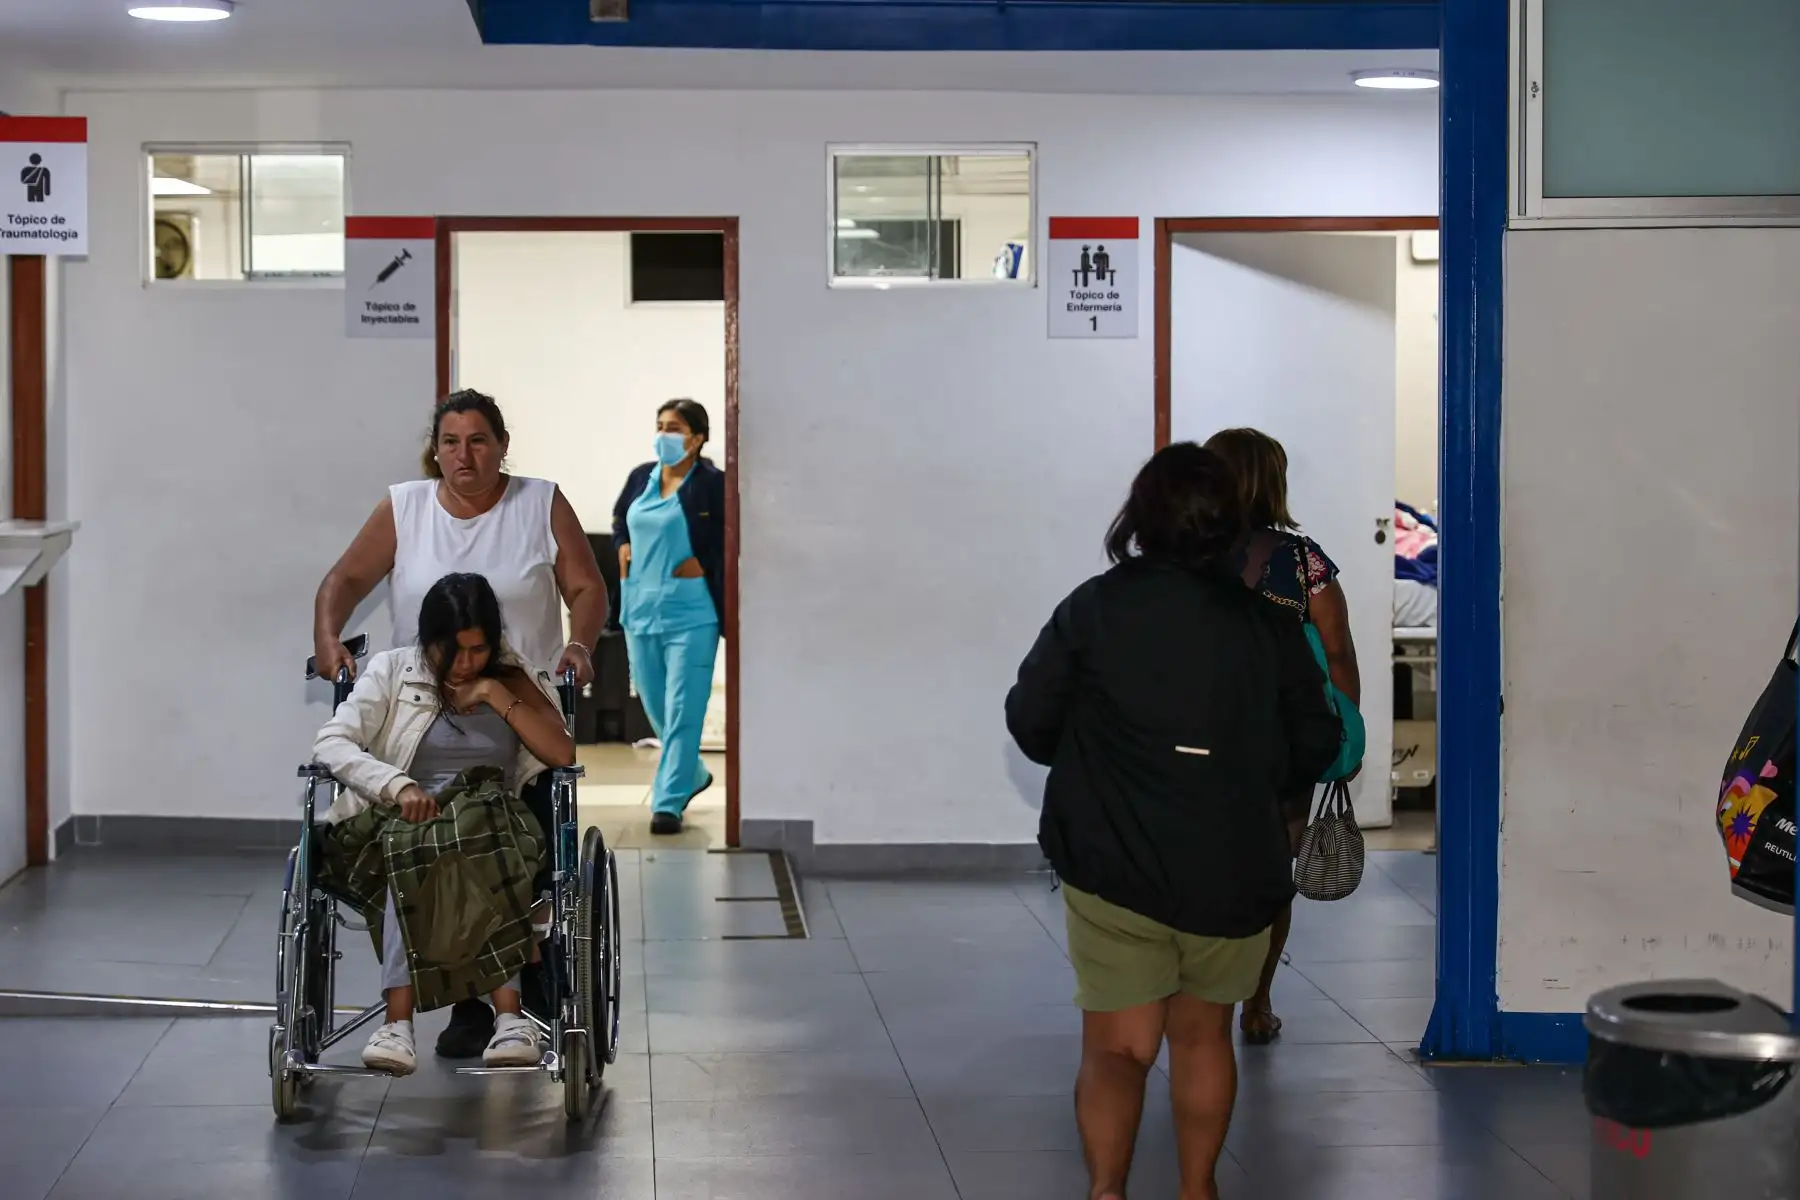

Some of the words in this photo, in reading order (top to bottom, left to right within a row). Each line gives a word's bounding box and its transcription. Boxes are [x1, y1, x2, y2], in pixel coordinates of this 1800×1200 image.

[7, 213, 47, 226] Tópico
[51, 213, 66, 225] de
[1070, 290, 1104, 301] Tópico
[1107, 290, 1120, 299] de
[365, 301, 400, 312] Tópico
[403, 301, 416, 311] de
[1066, 302, 1122, 312] Enfermería
[361, 314, 419, 325] Inyectables
[1089, 316, 1097, 331] 1
